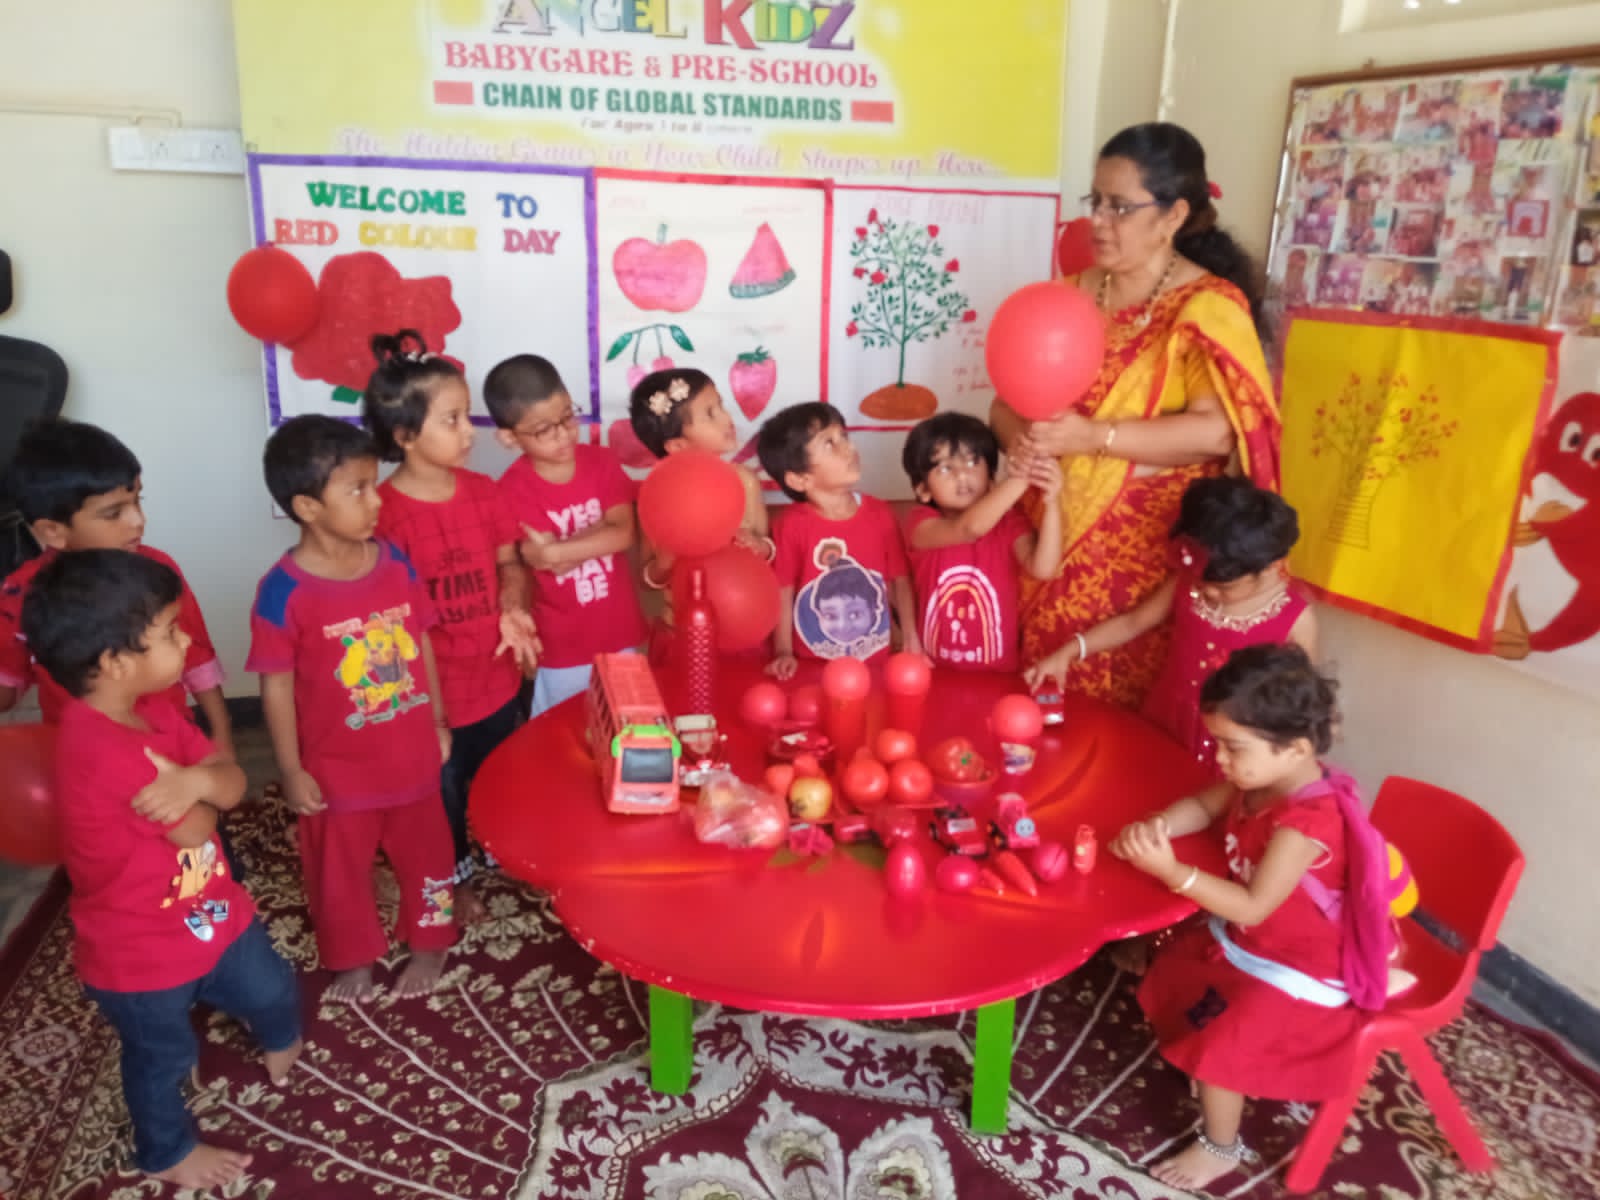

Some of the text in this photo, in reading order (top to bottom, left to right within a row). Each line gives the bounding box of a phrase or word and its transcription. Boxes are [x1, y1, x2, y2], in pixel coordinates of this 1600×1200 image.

[444, 41, 633, 77] BABYCARE
[671, 54, 877, 89] PRE-SCHOOL
[483, 82, 842, 121] CHAIN OF GLOBAL STANDARDS
[306, 181, 538, 218] WELCOME TO
[274, 218, 339, 246] RED
[503, 228, 561, 254] DAY
[546, 497, 602, 540] YES
[427, 568, 488, 601] TIME
[575, 573, 610, 607] BE
